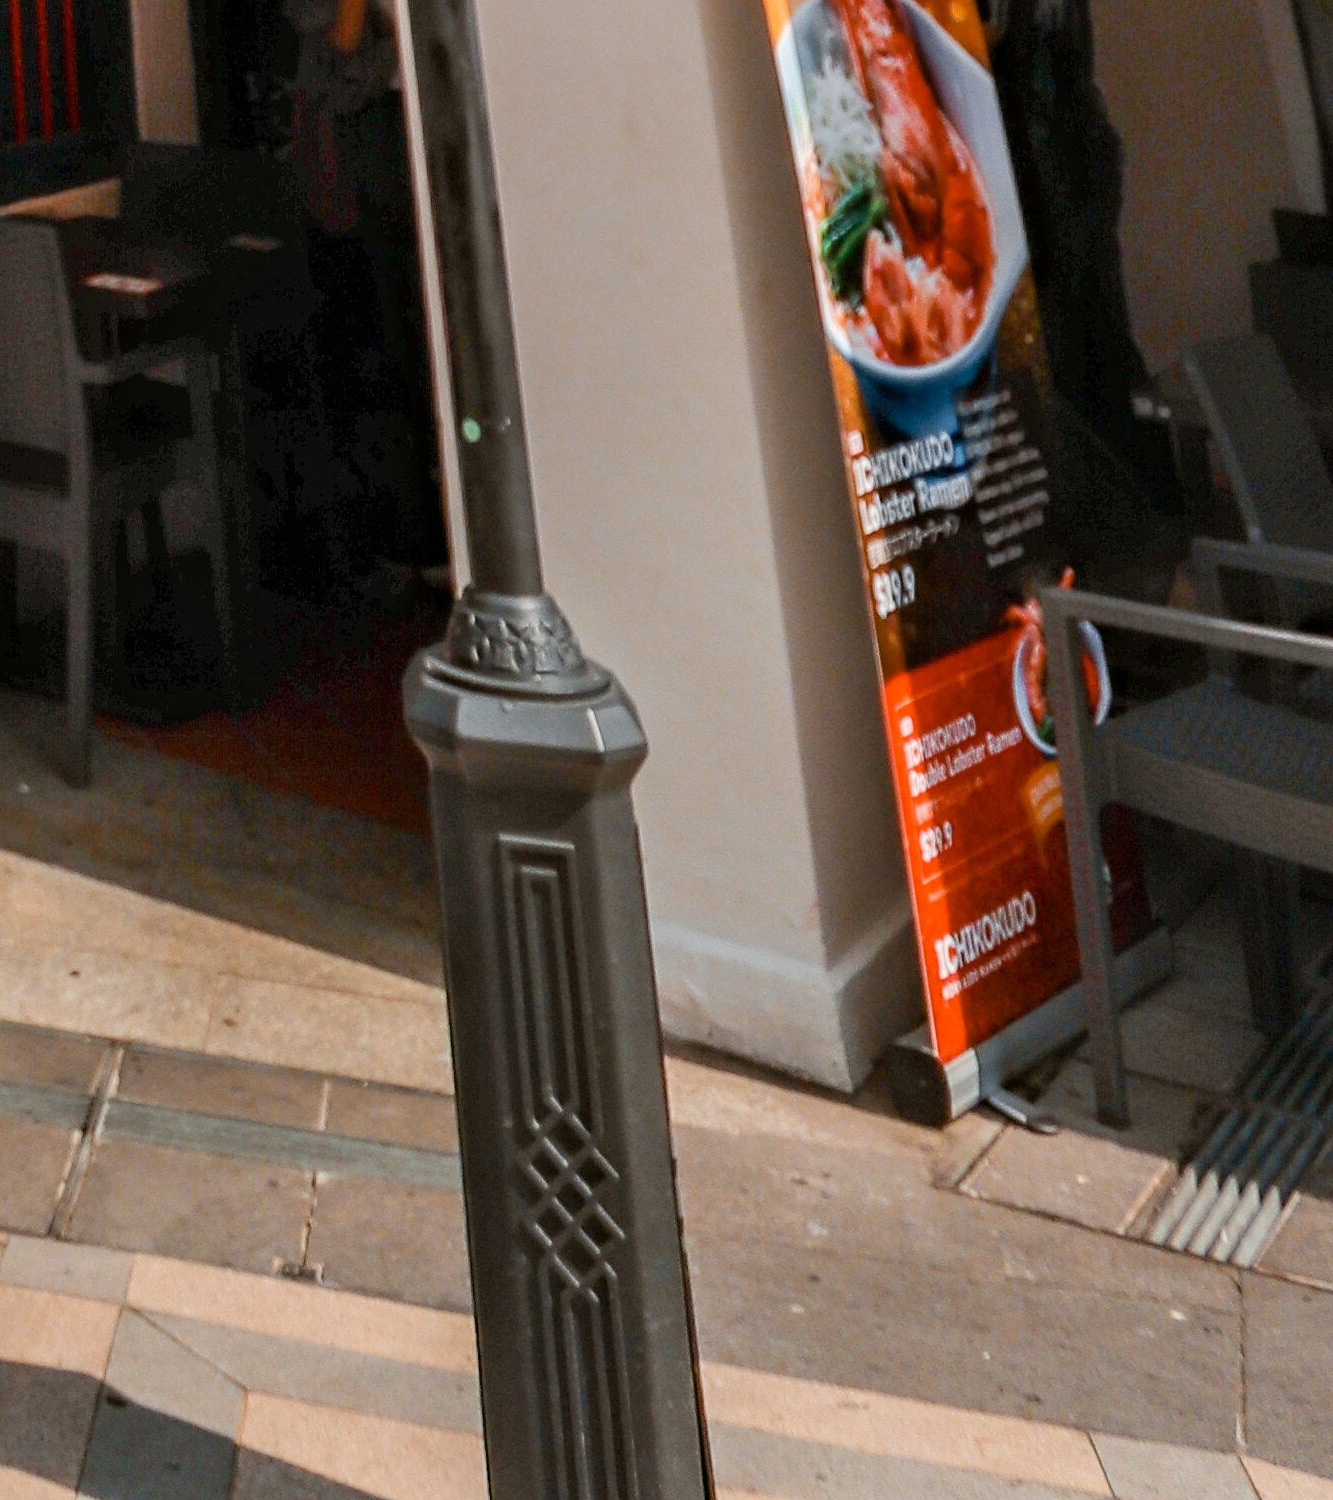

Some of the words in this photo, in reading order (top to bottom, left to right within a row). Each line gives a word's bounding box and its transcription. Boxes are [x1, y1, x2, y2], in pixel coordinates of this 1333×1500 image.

[851, 430, 955, 497] ICHIKOKUDO
[858, 487, 917, 536] Lobster
[914, 472, 973, 513] Ramen
[872, 563, 915, 619] $19.9
[903, 712, 977, 770] ICHIKOKUDO
[934, 890, 1037, 980] ICHIKOKUDO
